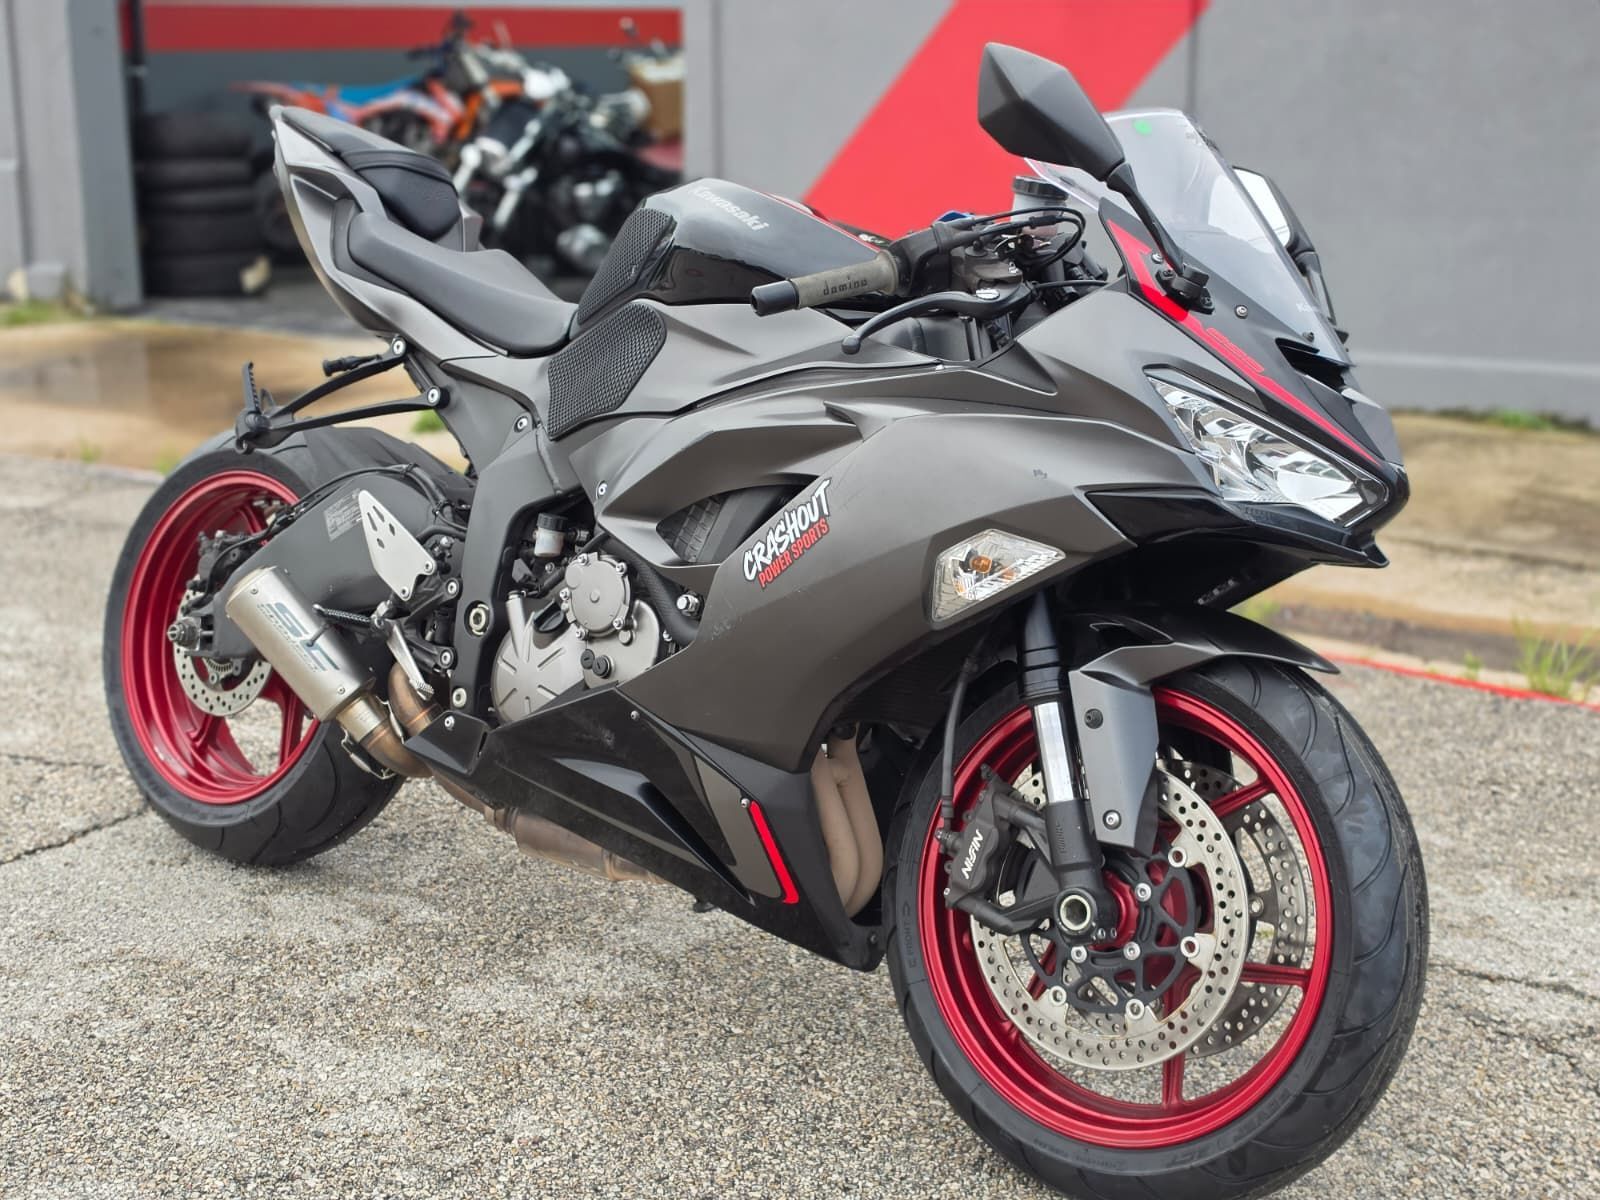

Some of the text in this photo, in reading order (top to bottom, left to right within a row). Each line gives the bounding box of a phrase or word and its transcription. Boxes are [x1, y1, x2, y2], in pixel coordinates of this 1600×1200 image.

[823, 274, 868, 296] domino
[743, 478, 831, 581] CRASHOUT
[758, 517, 830, 588] POWER SPORTS
[961, 828, 984, 880] NISSIN
